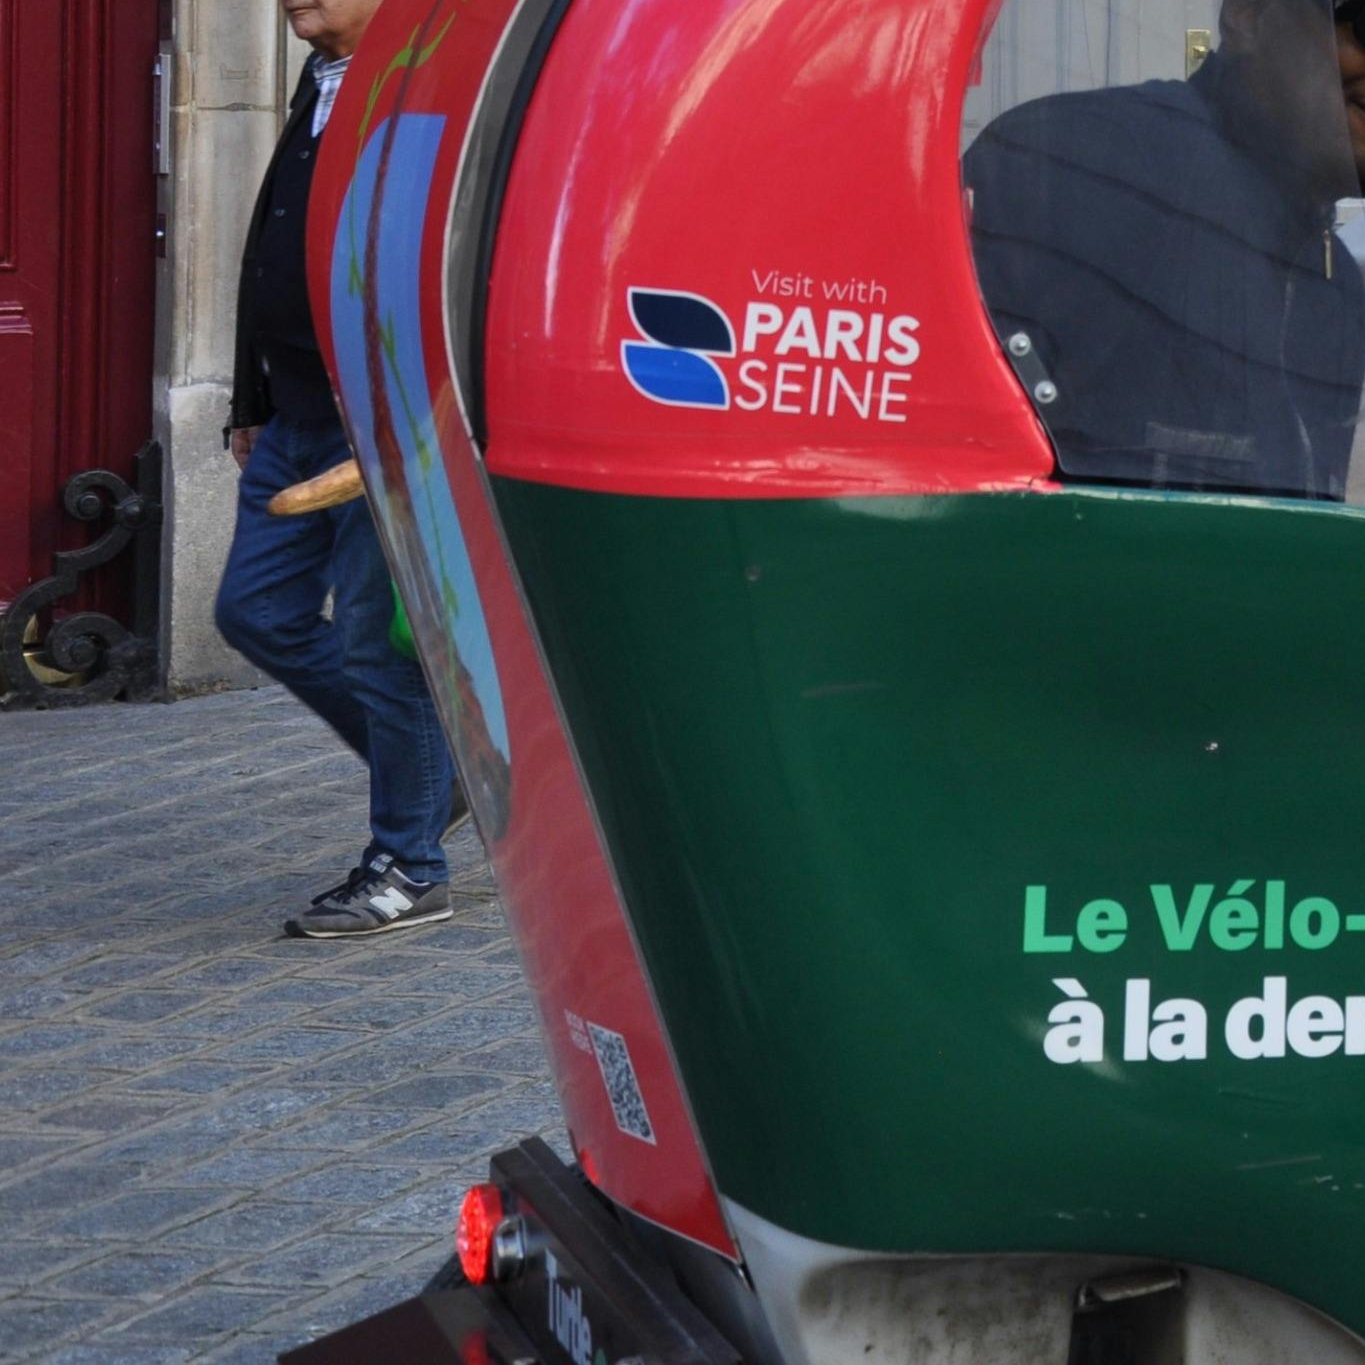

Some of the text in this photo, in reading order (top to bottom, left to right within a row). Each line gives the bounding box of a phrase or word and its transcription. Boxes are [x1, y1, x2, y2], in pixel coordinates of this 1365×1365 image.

[751, 269, 888, 304] Visit with
[741, 301, 921, 366] PARIS
[734, 359, 912, 423] SEINE
[368, 886, 414, 920] N
[1022, 884, 1128, 954] Le
[1043, 977, 1105, 1064] à
[1123, 978, 1208, 1062] la
